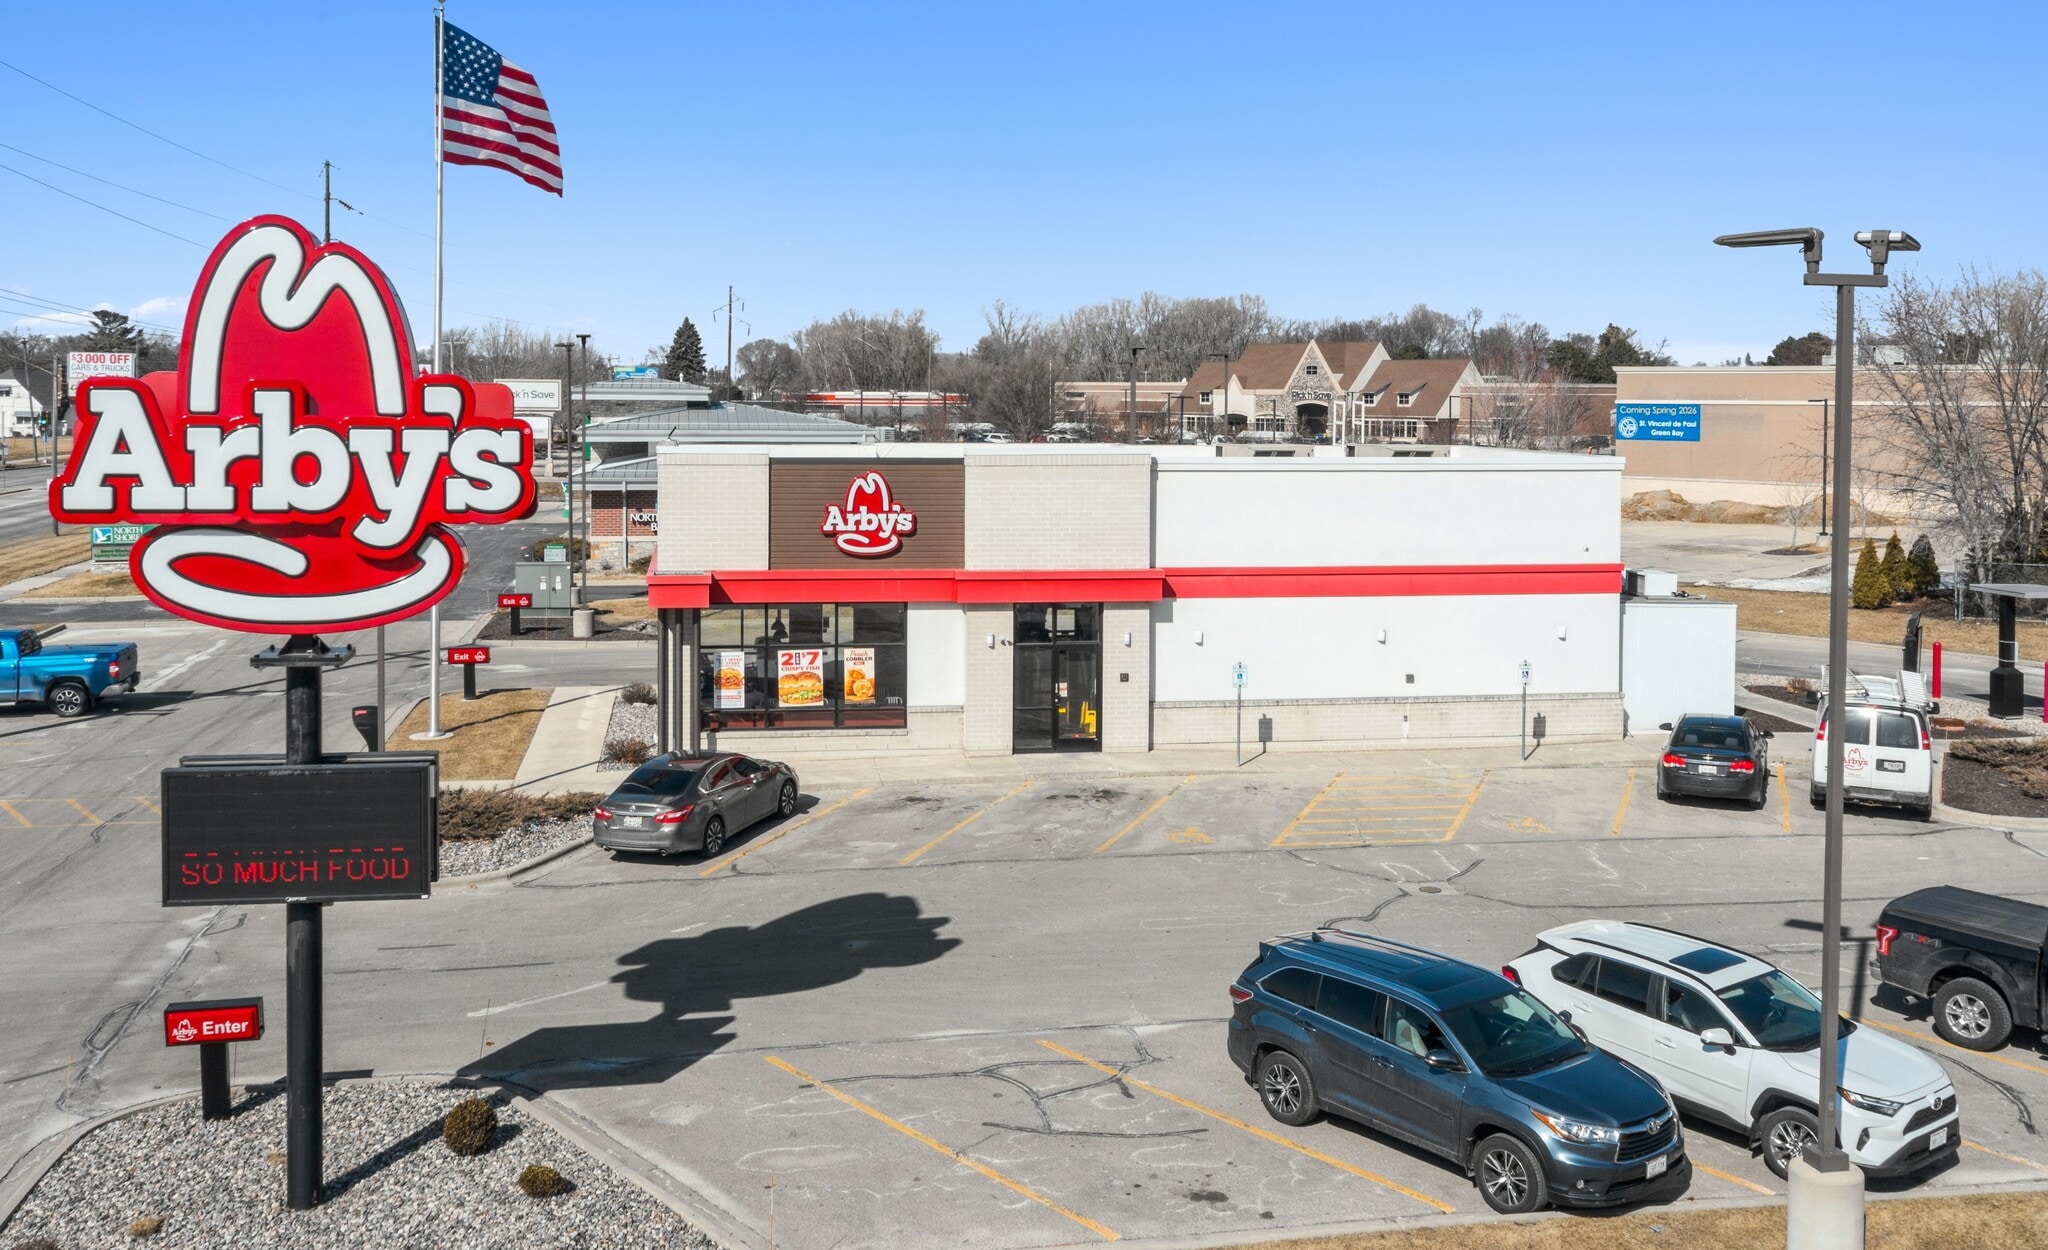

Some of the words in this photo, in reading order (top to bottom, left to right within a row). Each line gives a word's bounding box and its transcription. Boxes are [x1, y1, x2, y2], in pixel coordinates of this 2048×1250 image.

[110, 354, 130, 364] OFF
[93, 364, 98, 372] &
[101, 364, 130, 372] TRUCKS
[530, 390, 555, 399] Save
[1313, 390, 1332, 400] Save
[1619, 406, 1651, 416] Coming
[1652, 406, 1677, 416] Spring
[1678, 407, 1698, 415] 2026
[1672, 420, 1682, 428] de
[1682, 420, 1697, 428] Paul
[1671, 429, 1684, 437] Bay
[62, 385, 523, 548] Arby's
[823, 504, 912, 539] Arby's
[113, 526, 143, 534] NORTH
[454, 653, 469, 661] Exit
[781, 652, 794, 666] 2
[801, 651, 819, 665] $7
[182, 852, 224, 886] SO
[234, 850, 319, 883] MUCH
[328, 847, 410, 880] FOOD
[202, 1020, 249, 1036] Enter
